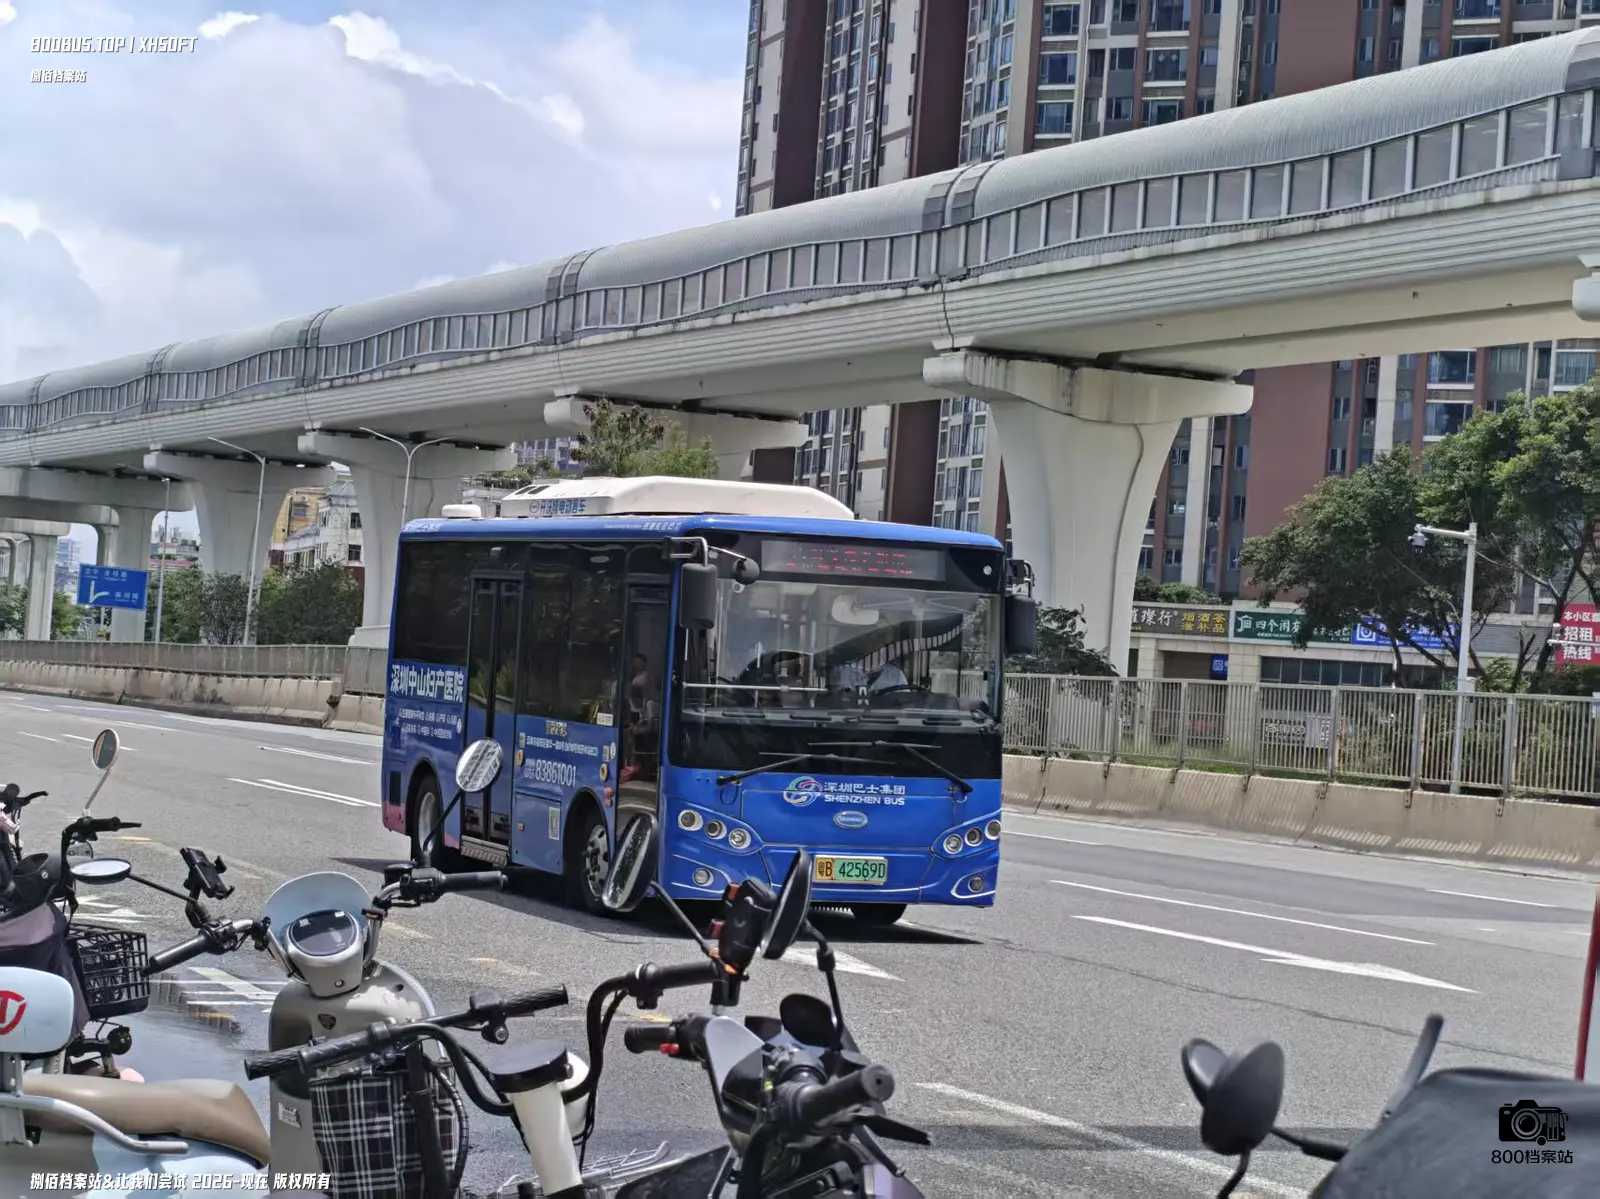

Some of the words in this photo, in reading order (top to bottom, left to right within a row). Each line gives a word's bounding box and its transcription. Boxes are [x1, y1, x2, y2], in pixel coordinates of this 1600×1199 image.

[1563, 626, 1593, 641] 招租
[1563, 645, 1592, 660] 热线
[390, 664, 465, 703] 深圳中山妇产医院
[535, 759, 577, 787] 83861001
[824, 794, 881, 804] SHENZHEN
[884, 797, 905, 806] BUS
[838, 861, 886, 879] 42569D
